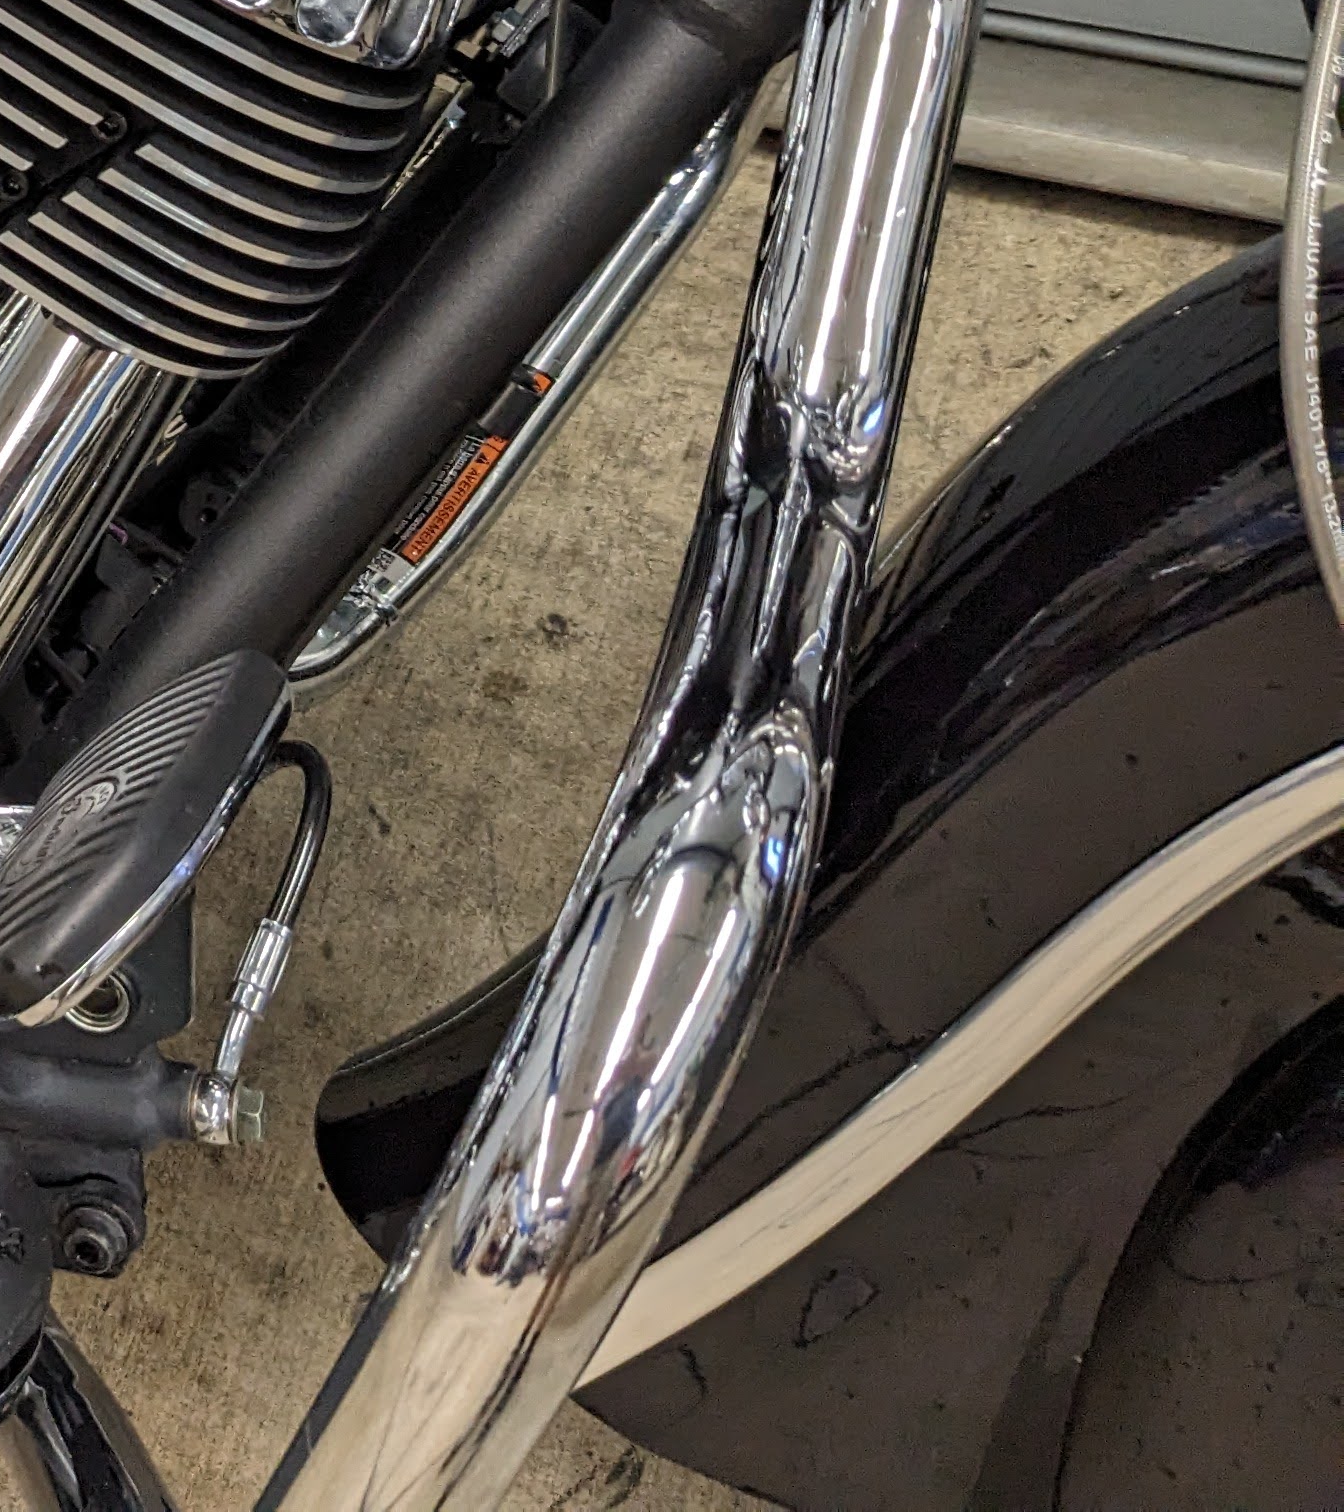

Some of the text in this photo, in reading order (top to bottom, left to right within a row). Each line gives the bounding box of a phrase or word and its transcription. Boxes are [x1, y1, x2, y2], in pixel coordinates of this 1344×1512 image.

[1304, 310, 1319, 362] SAE
[1305, 372, 1324, 432] J1401
[410, 467, 481, 554] AVERTISSEMENT
